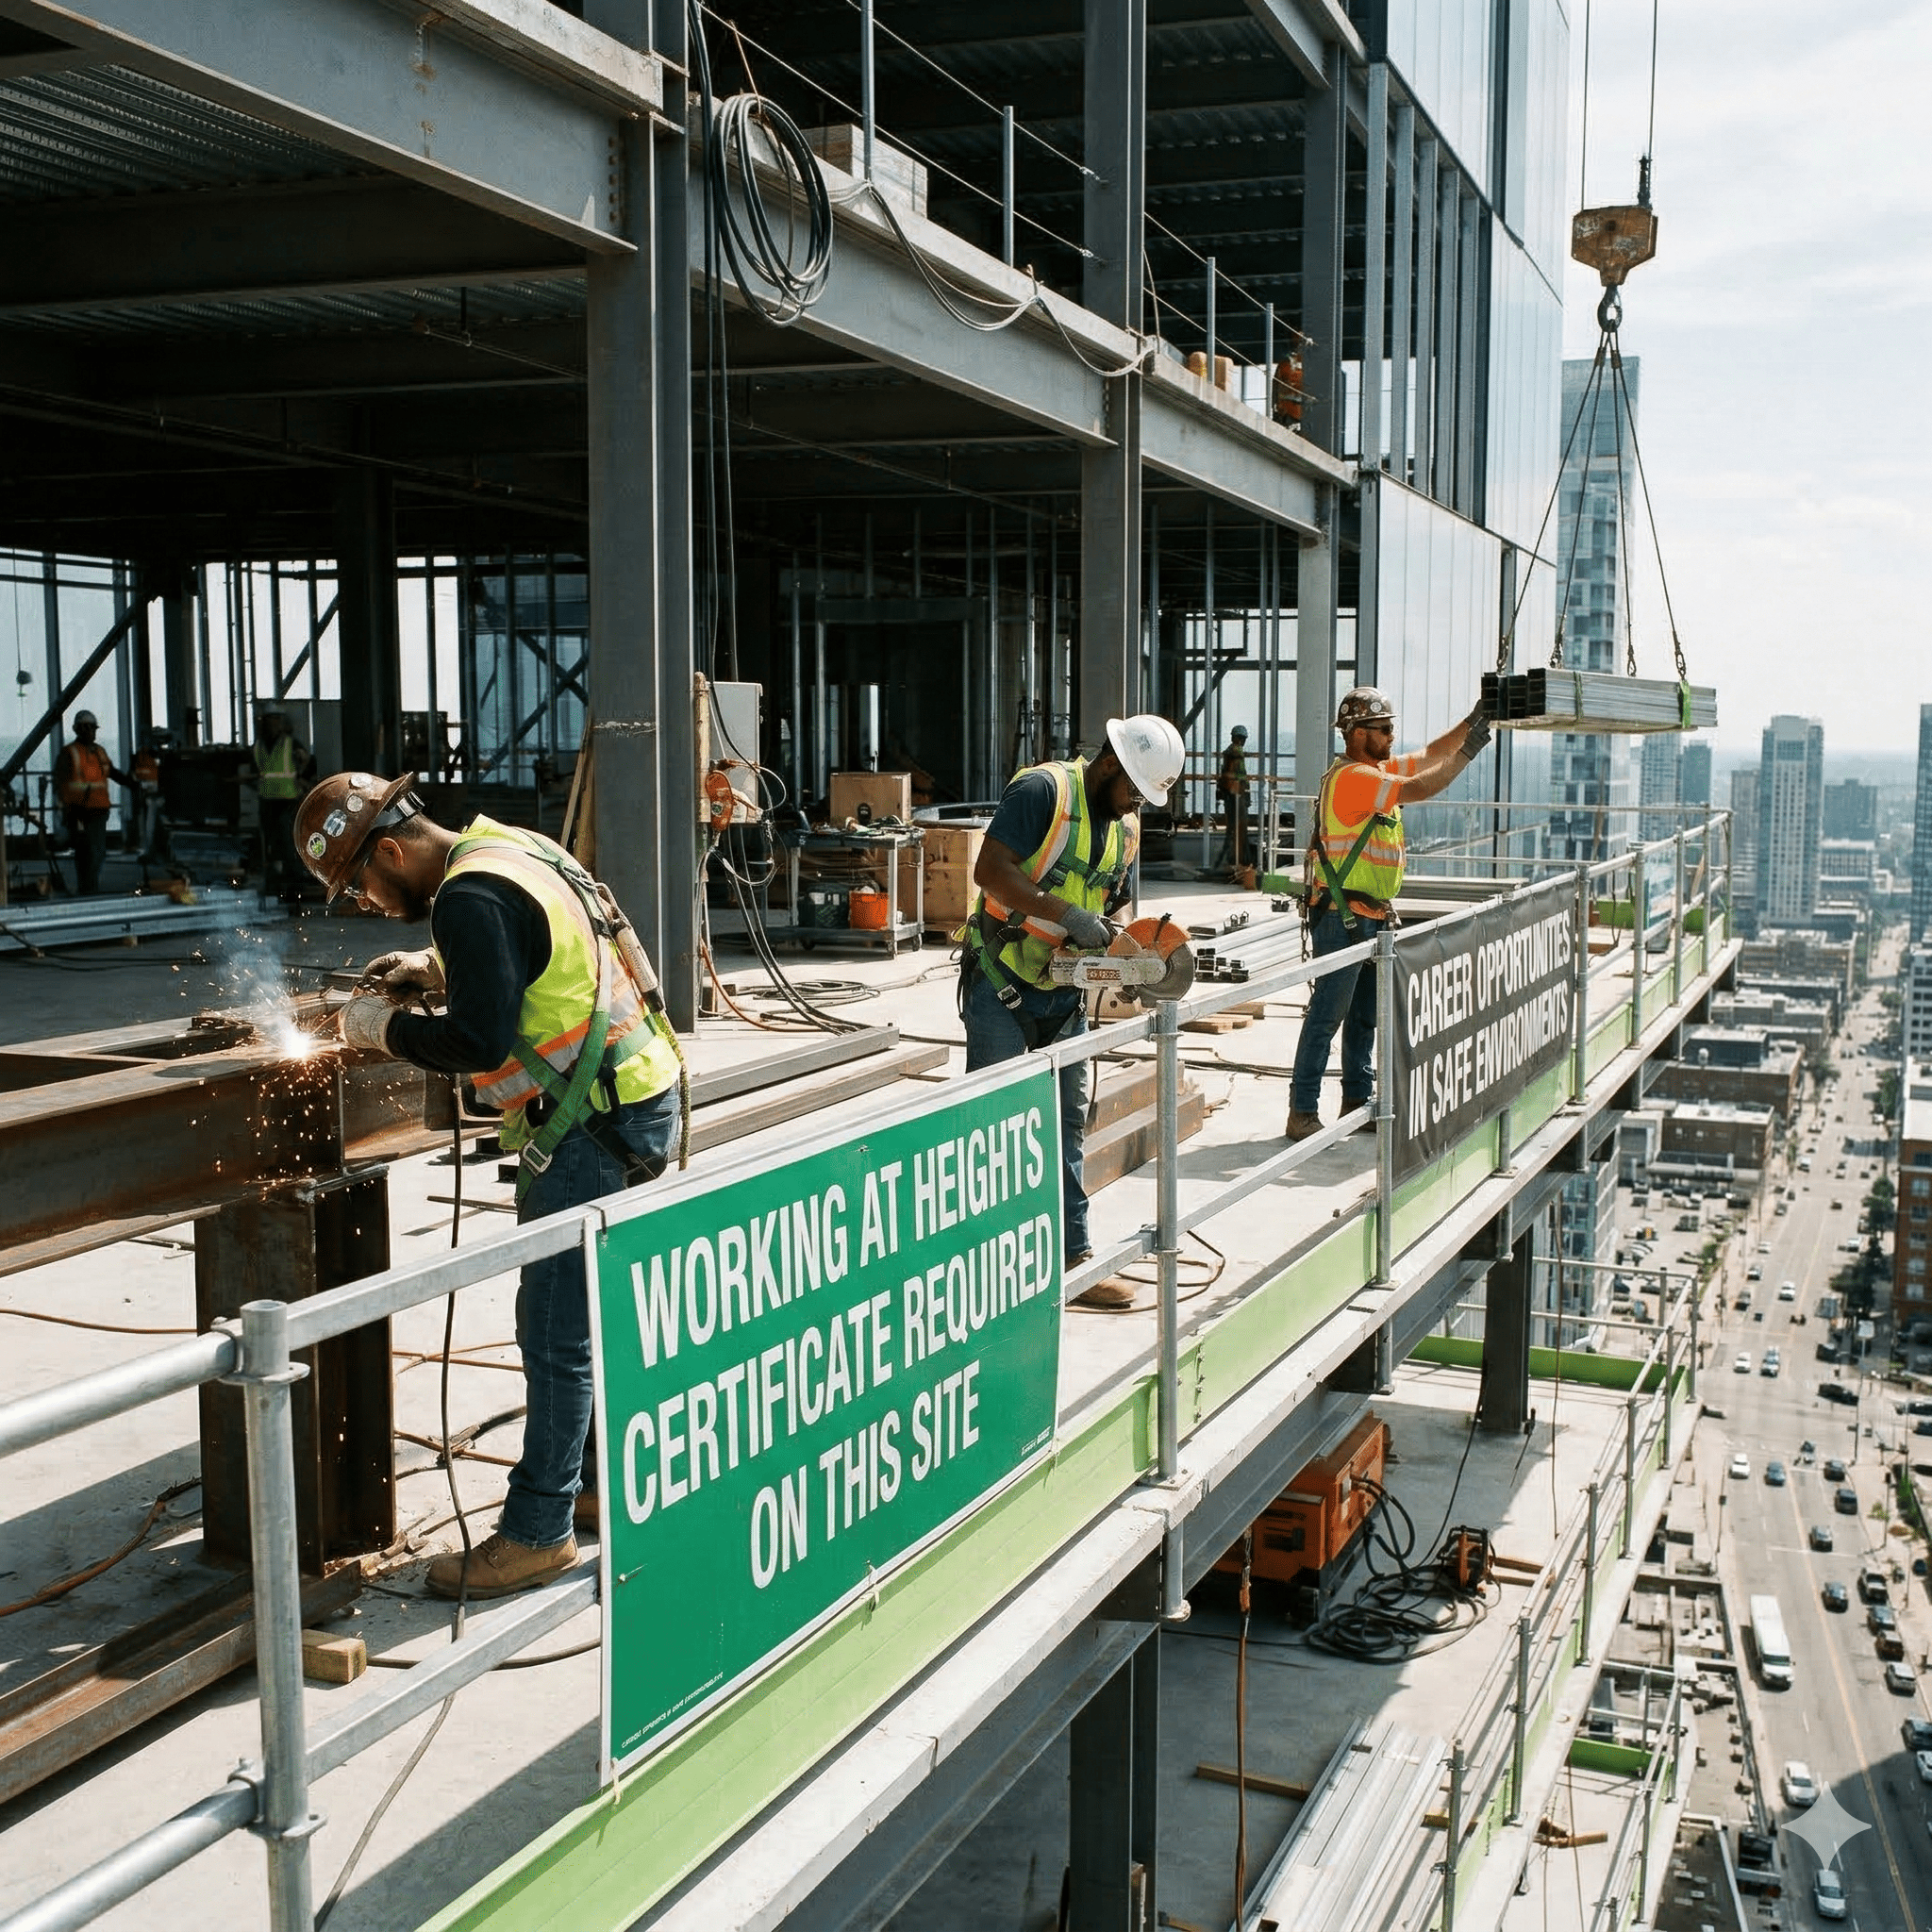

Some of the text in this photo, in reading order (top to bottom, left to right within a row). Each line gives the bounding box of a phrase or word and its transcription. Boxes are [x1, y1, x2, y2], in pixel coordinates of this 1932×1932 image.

[1407, 909, 1571, 1048] CAREER OPPORTUNITIES
[1408, 979, 1568, 1141] IN SAFE ENVIRONMENTS
[630, 1107, 1043, 1369] WORKING AT HEIGHTS
[623, 1212, 1054, 1524] CERTIFICATE REQUIRED
[751, 1359, 980, 1590] ON THIS SITE
